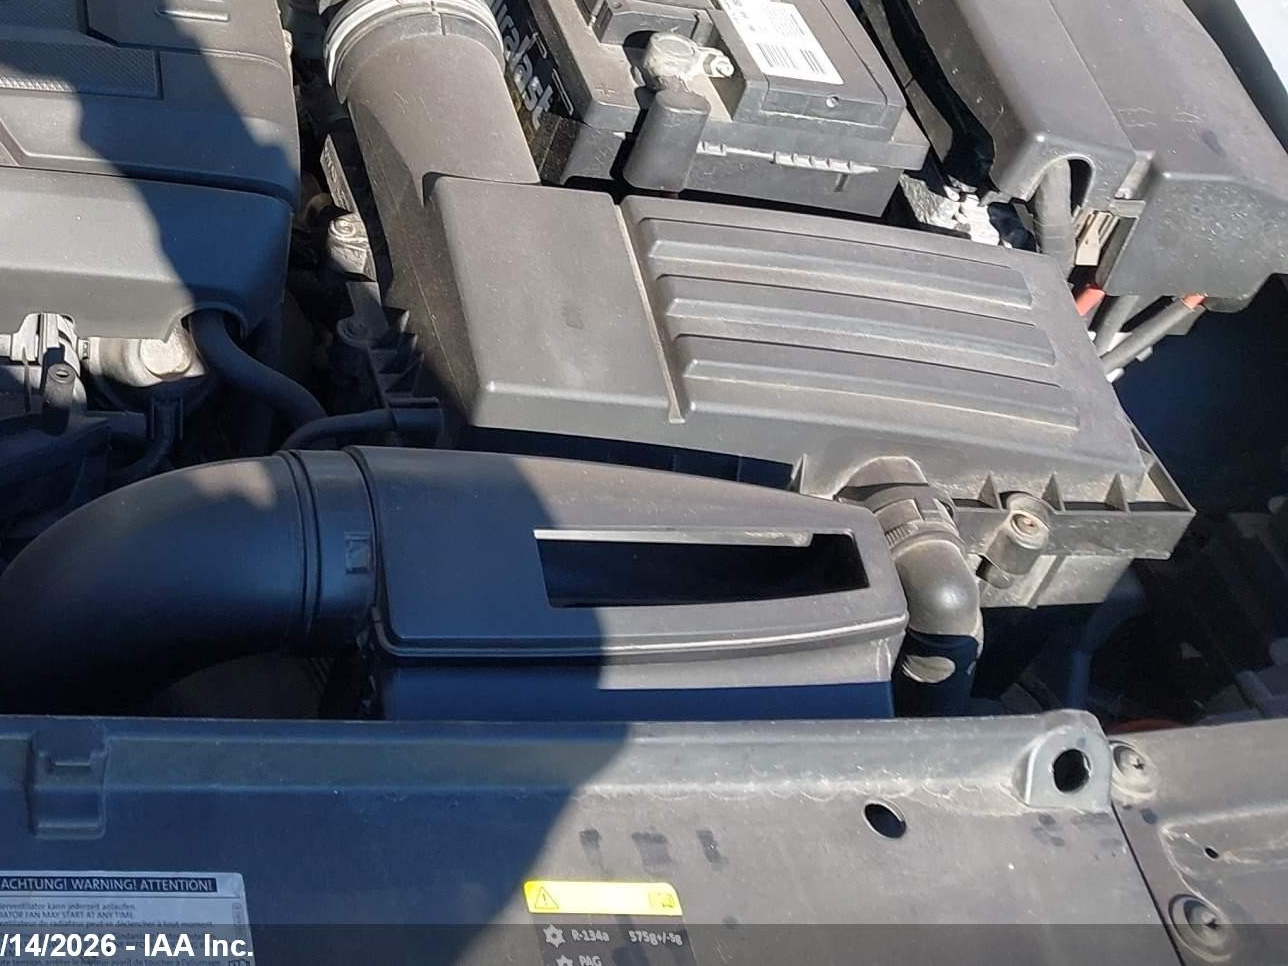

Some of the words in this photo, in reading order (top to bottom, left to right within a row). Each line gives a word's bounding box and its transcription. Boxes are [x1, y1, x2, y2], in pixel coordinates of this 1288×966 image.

[0, 878, 68, 891] ACHTUNG!
[71, 878, 137, 891] WARNING!
[140, 879, 213, 892] ATTENTION!
[25, 911, 41, 920] FAN
[42, 911, 60, 920] MAY
[62, 911, 84, 920] START
